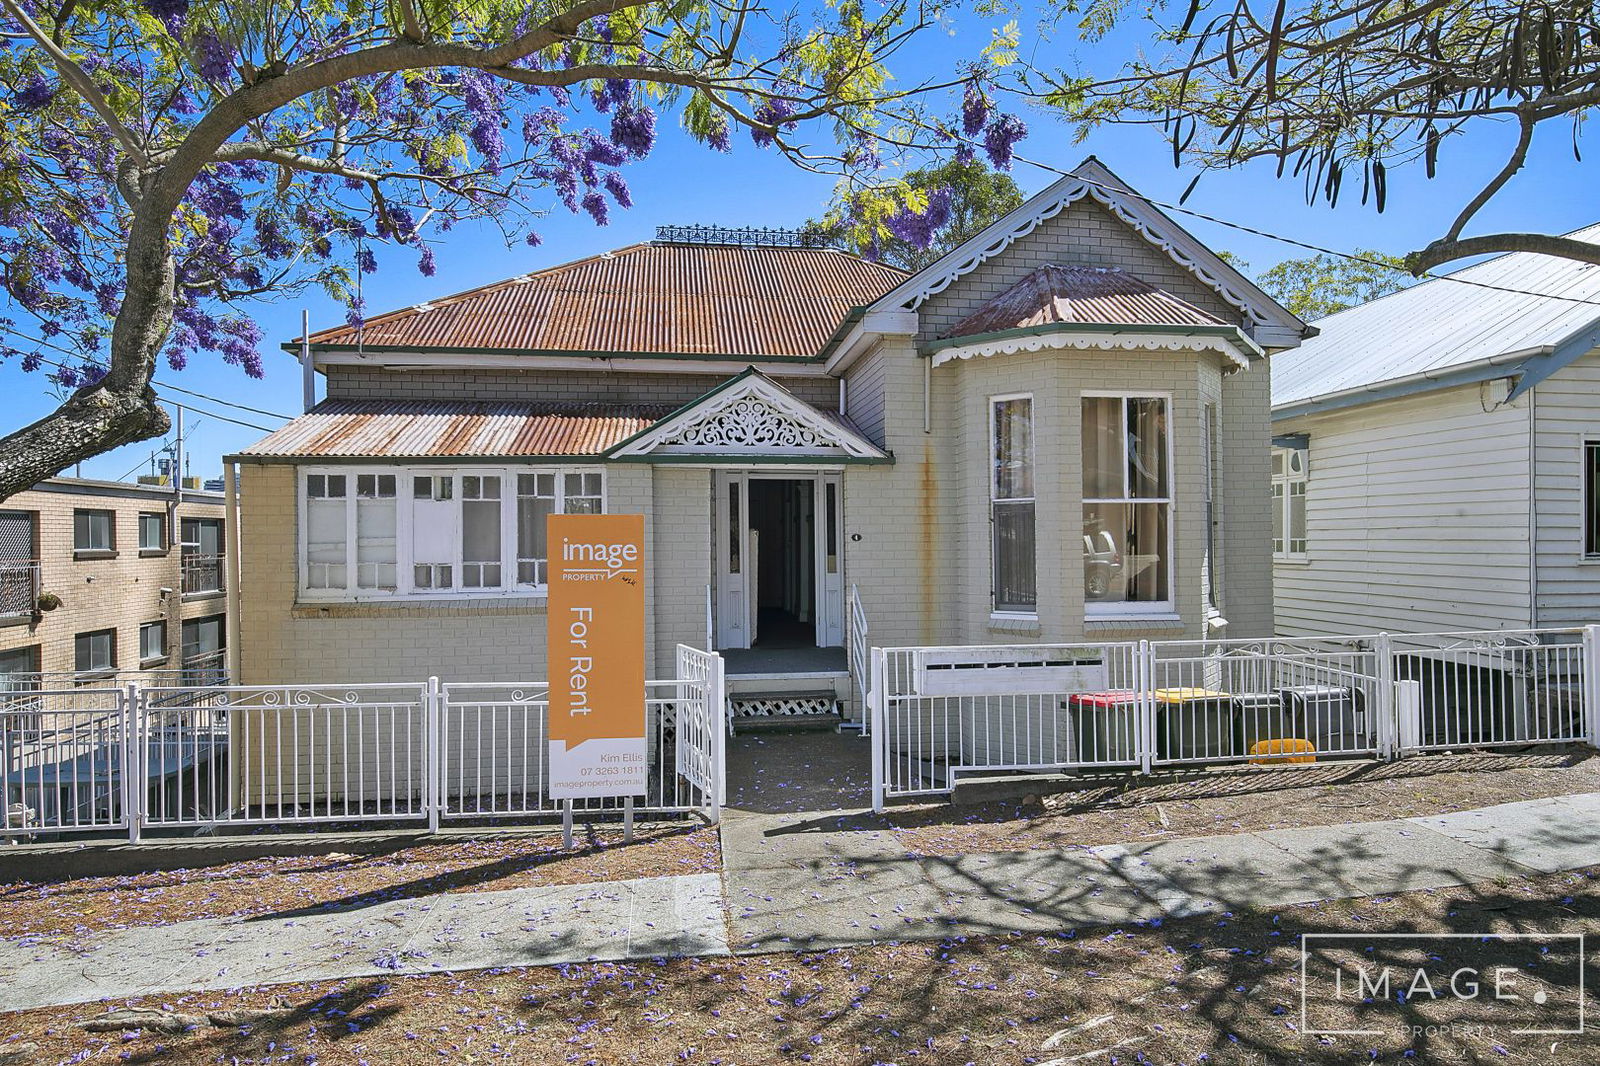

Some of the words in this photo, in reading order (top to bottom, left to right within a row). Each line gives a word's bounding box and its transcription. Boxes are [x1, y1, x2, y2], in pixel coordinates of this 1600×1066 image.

[563, 537, 638, 568] image
[562, 573, 606, 581] PROPERTY
[569, 607, 593, 649] For
[569, 656, 593, 717] Rent
[600, 754, 620, 762] Kim
[622, 752, 643, 761] Ellis
[580, 767, 593, 776] 07
[622, 766, 643, 774] 1811
[554, 779, 643, 789] imageproperty.com.au
